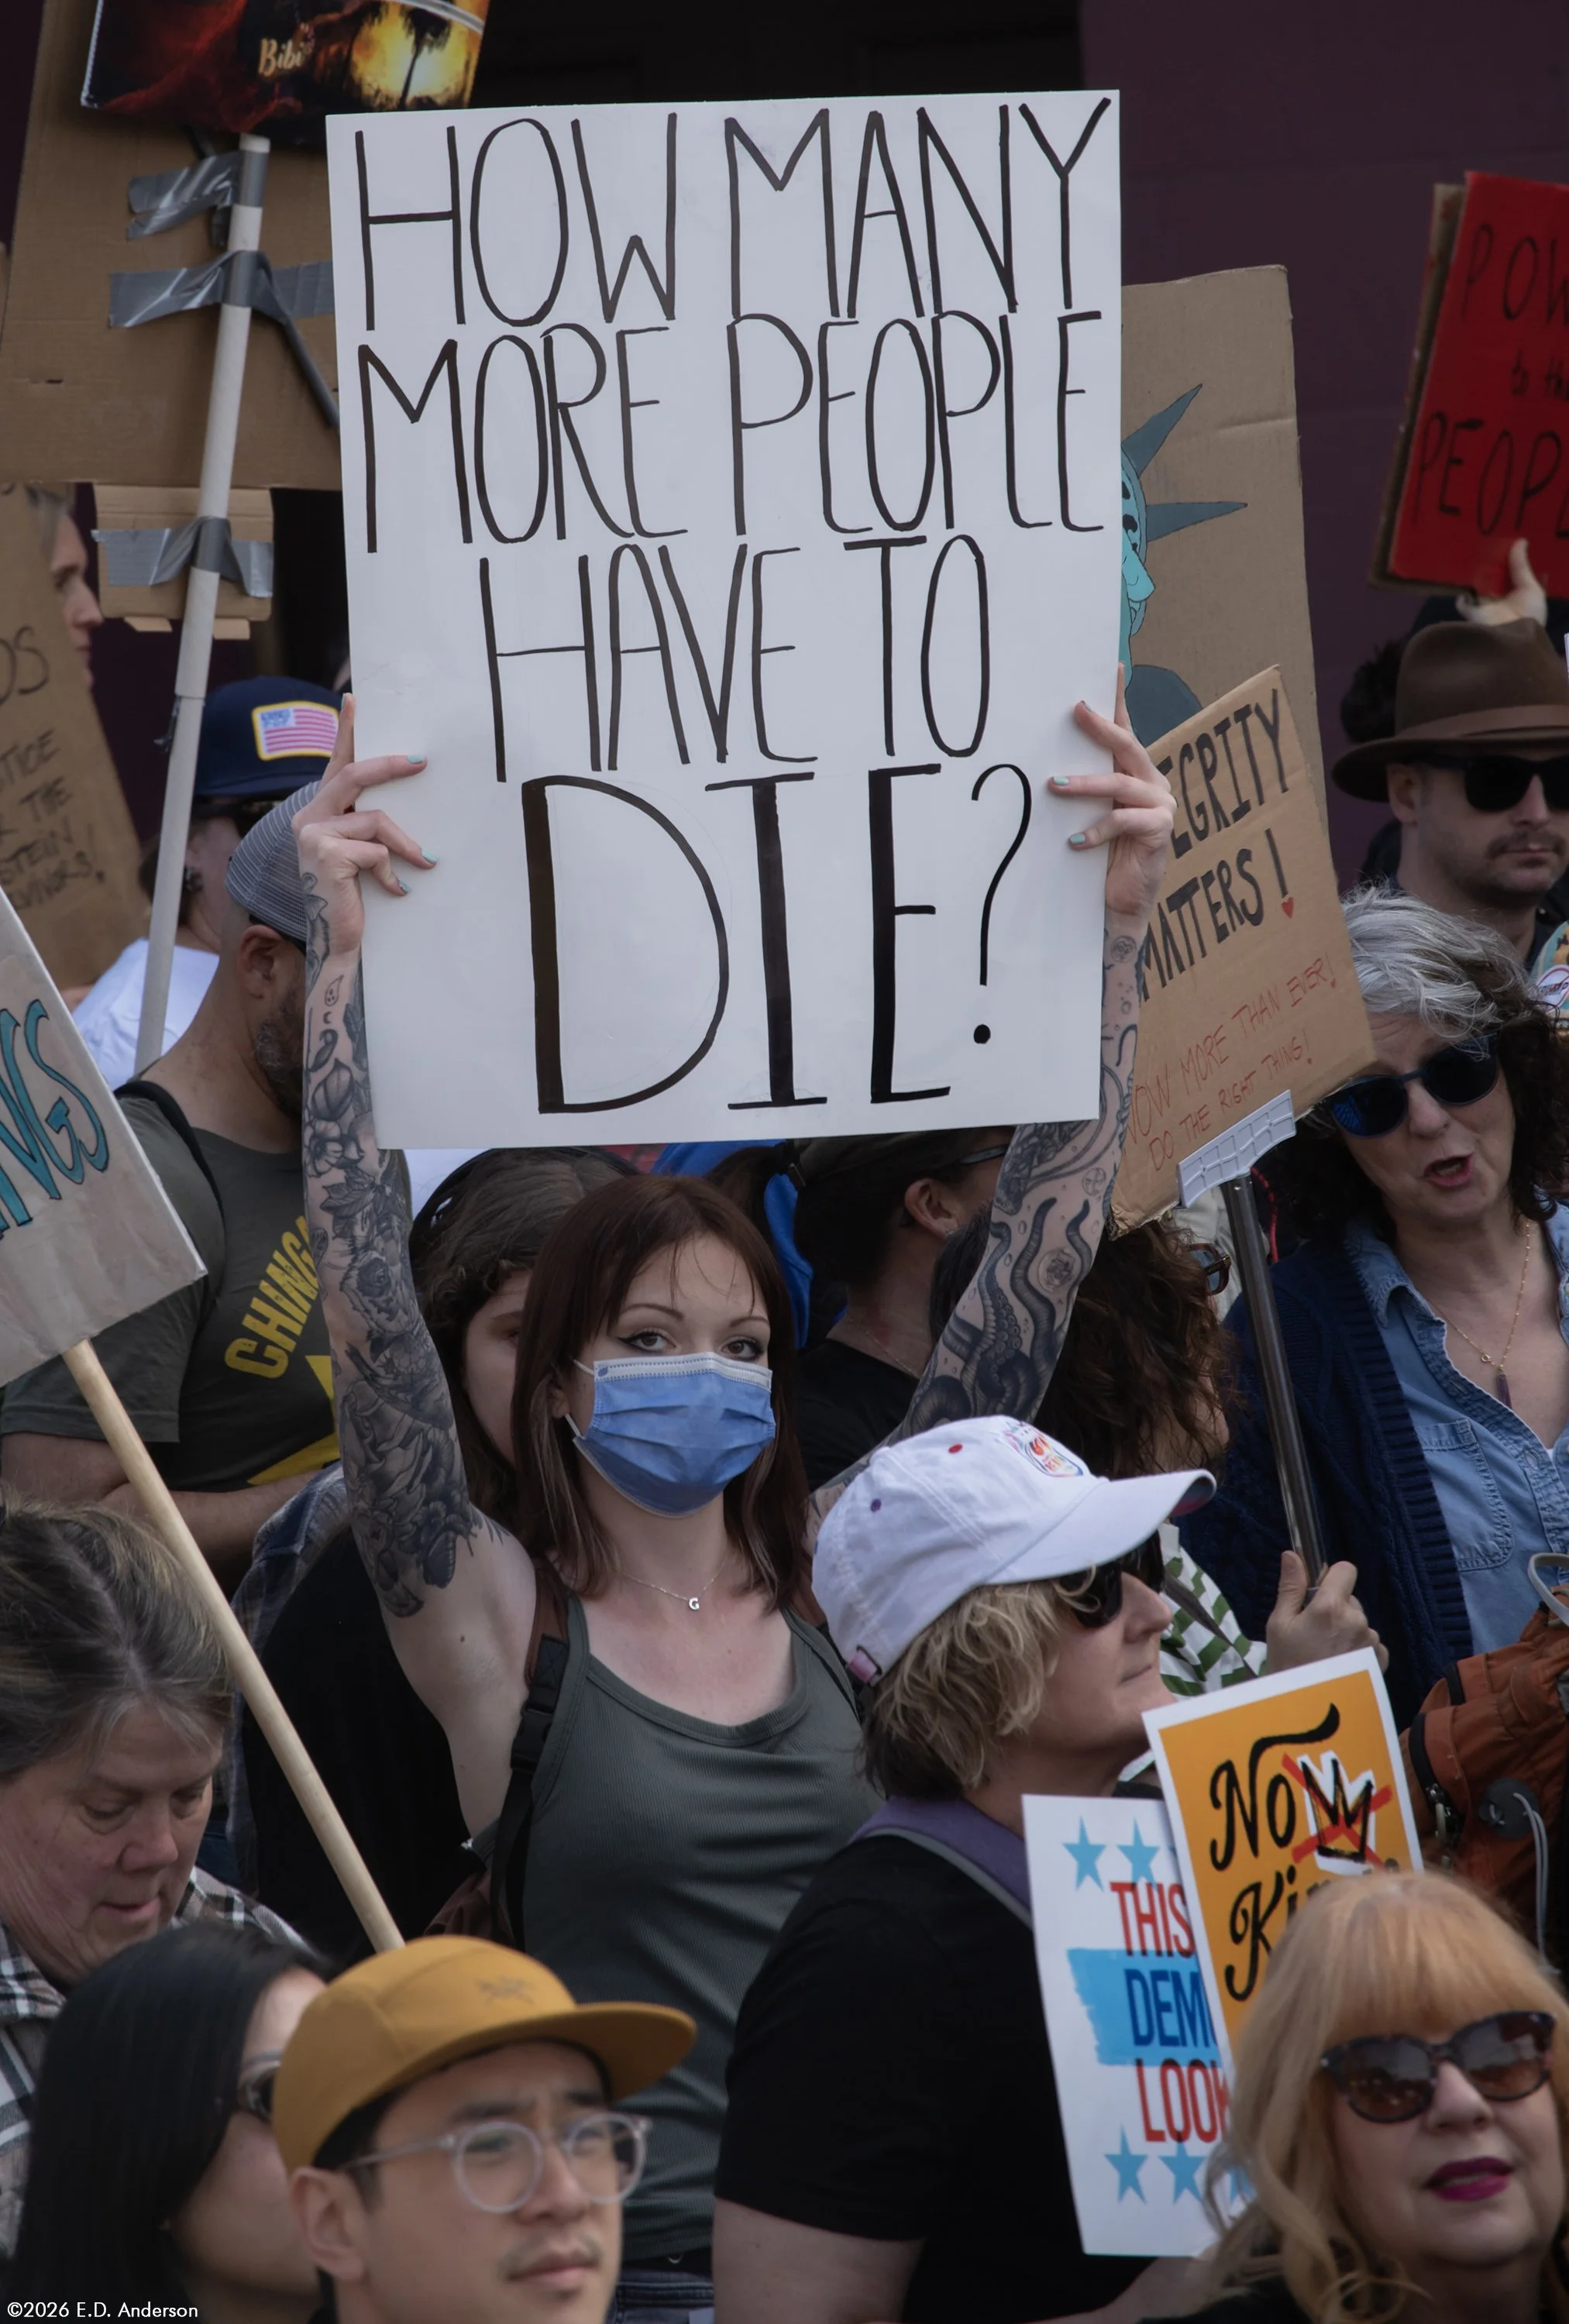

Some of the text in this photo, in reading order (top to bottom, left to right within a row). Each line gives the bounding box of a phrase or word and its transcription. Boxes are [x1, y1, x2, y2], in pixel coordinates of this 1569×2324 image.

[355, 98, 1111, 330] HOW MANY
[358, 311, 1104, 553] MORE PEOPLE
[480, 535, 990, 782] HAVE TO
[521, 763, 1032, 1114] DIE?
[1149, 1027, 1313, 1171] DO THE RIGHT THING!
[1179, 1024, 1230, 1095] MORE
[1231, 983, 1280, 1039] THAN
[1286, 951, 1337, 1008] EVER!
[1209, 1703, 1340, 1871] No
[1110, 1882, 1196, 1958] THIS
[1124, 1968, 1218, 2047] DEM
